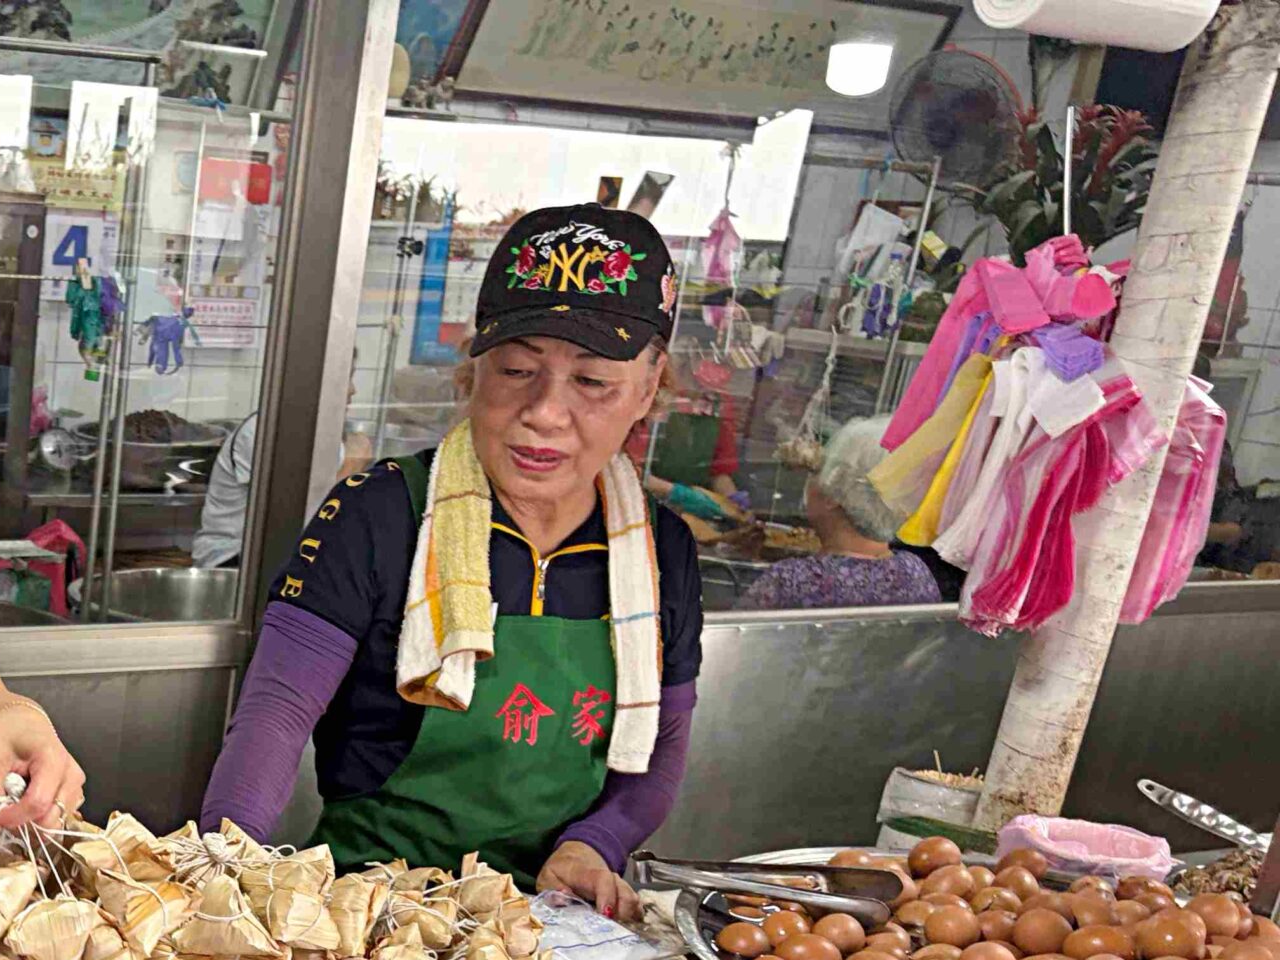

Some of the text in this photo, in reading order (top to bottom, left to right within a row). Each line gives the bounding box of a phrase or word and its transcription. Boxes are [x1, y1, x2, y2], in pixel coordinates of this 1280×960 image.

[52, 225, 91, 269] 4
[572, 223, 625, 251] York
[544, 242, 590, 292] NY
[495, 682, 612, 747] 俞家
